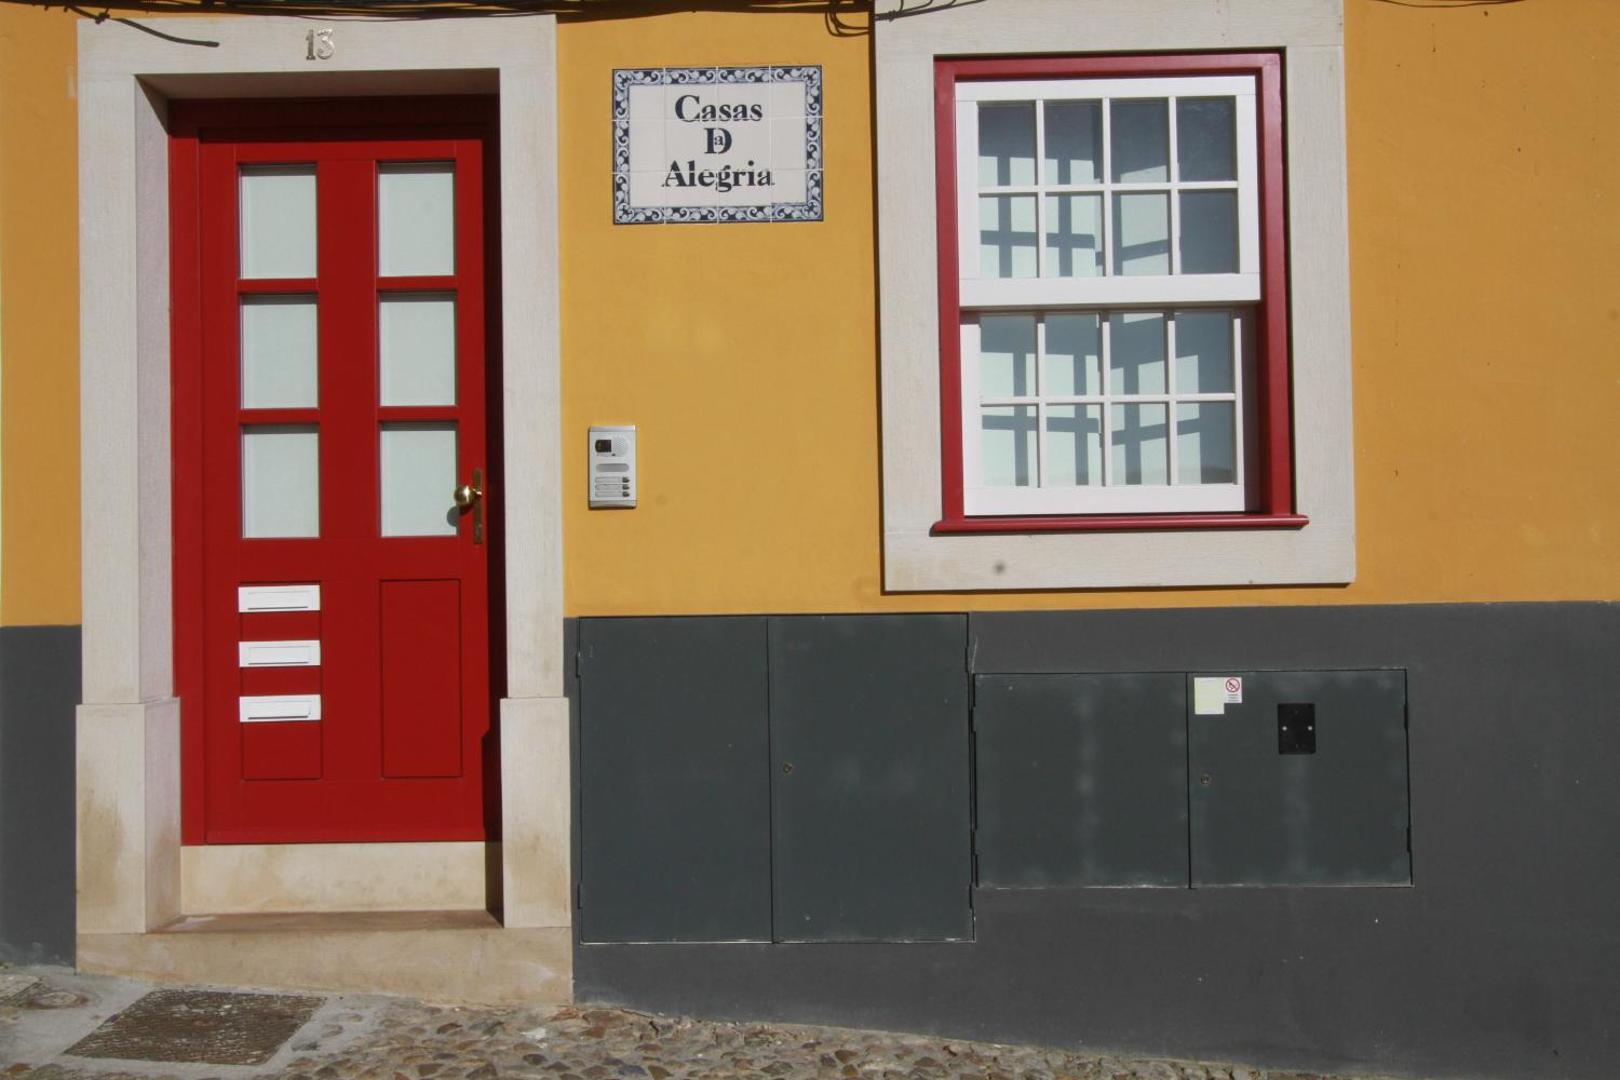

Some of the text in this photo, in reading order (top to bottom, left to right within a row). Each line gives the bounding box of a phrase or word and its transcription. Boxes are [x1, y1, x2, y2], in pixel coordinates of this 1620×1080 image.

[306, 28, 335, 60] 13
[674, 94, 763, 122] Casas
[661, 159, 775, 192] Alegria
